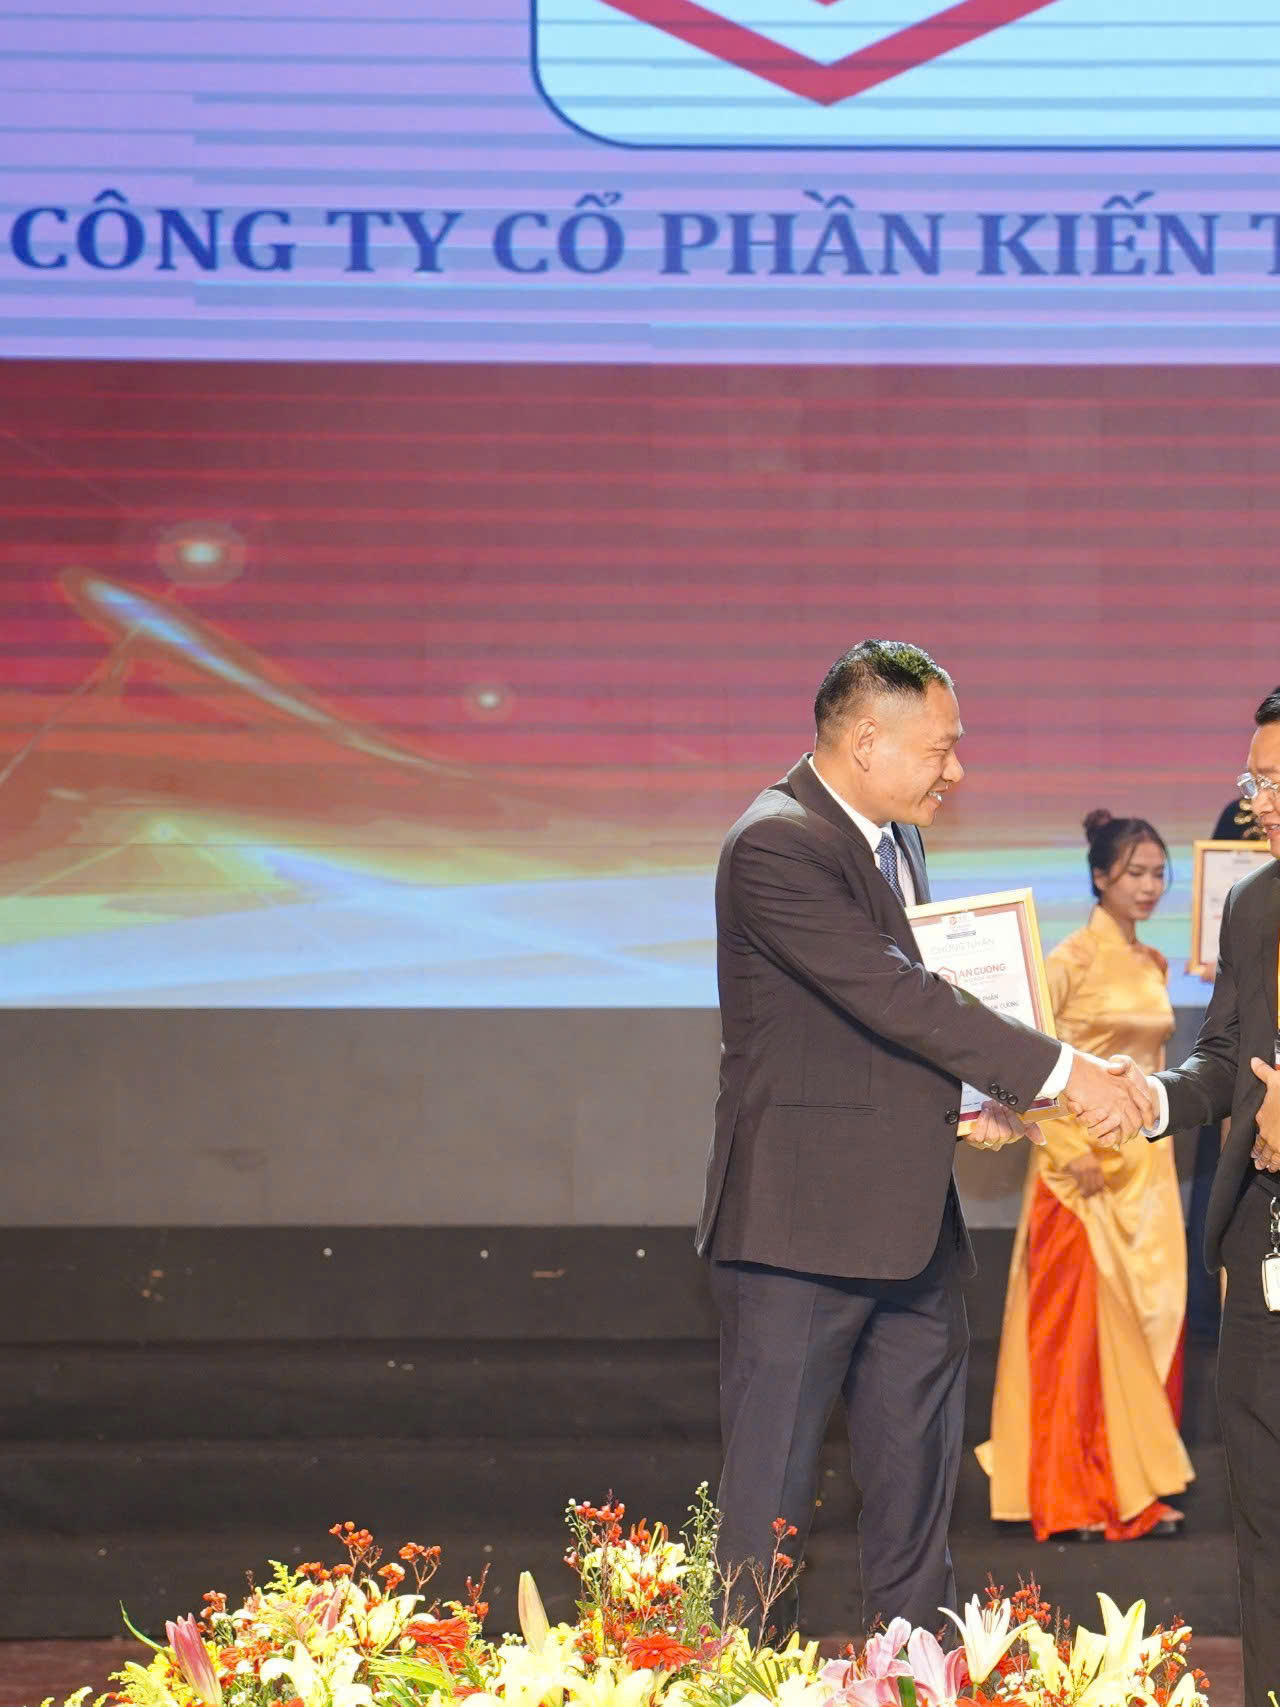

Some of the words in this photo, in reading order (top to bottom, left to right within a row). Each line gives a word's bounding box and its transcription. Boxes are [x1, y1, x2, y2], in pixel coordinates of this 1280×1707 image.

[9, 189, 297, 272] CÔNG
[325, 208, 465, 273] TY
[491, 191, 625, 274] CỔ
[658, 190, 945, 276] PHẦN
[976, 190, 1220, 276] KIẾN
